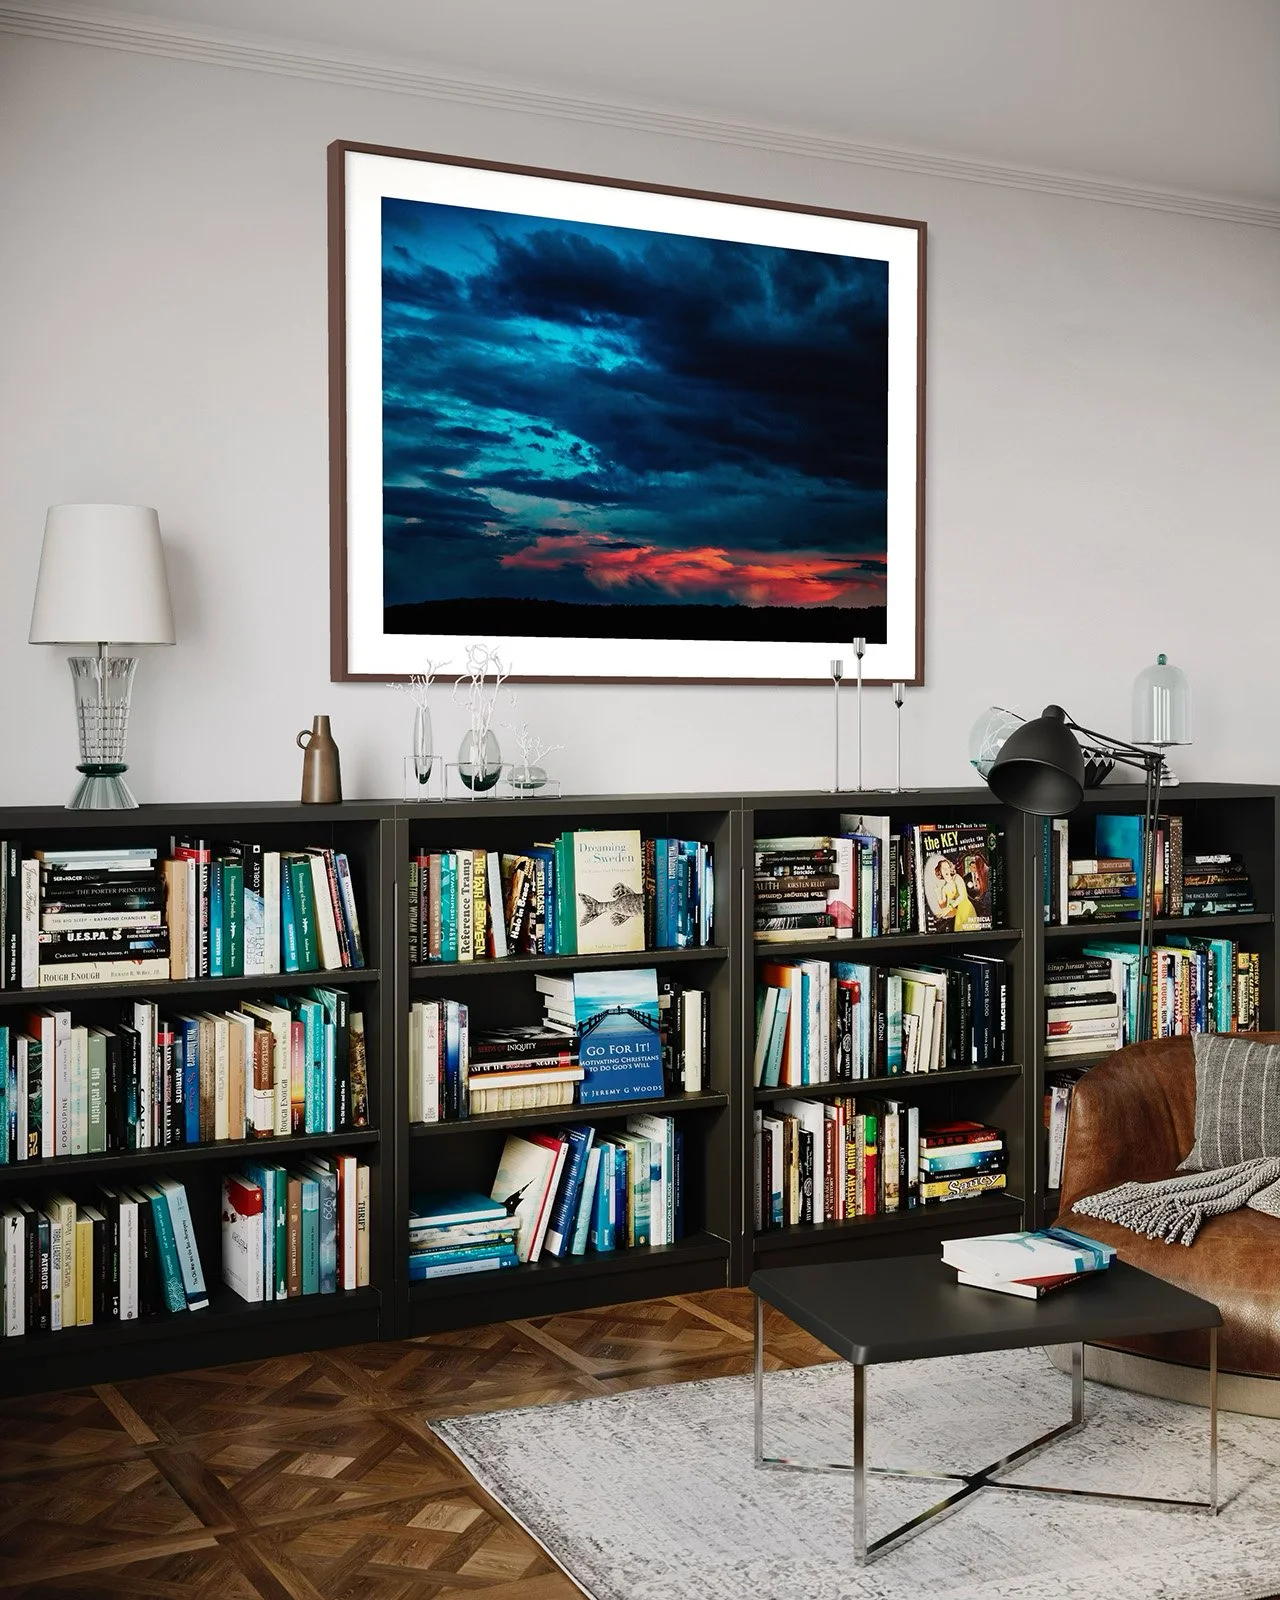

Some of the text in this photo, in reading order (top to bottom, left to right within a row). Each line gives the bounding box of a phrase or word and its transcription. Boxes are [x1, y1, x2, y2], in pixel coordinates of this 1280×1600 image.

[580, 842, 626, 852] Dreaming
[924, 831, 958, 850] the KEY
[594, 853, 634, 863] Sweden
[461, 859, 471, 954] Reference Tramp
[474, 856, 485, 954] THE PATH BETWEEN
[510, 883, 529, 939] Halo in Brass
[410, 933, 417, 942] IS
[44, 974, 69, 982] ROUGH
[507, 1042, 536, 1052] INIQUITY
[586, 1042, 650, 1056] GO FOR IT!
[580, 1055, 659, 1066] MOTIVATING CHRISTIANS
[592, 1089, 620, 1097] JEREMY
[92, 1088, 100, 1124] architecture
[949, 1174, 1001, 1197] Saucy
[323, 1197, 332, 1220] 1929
